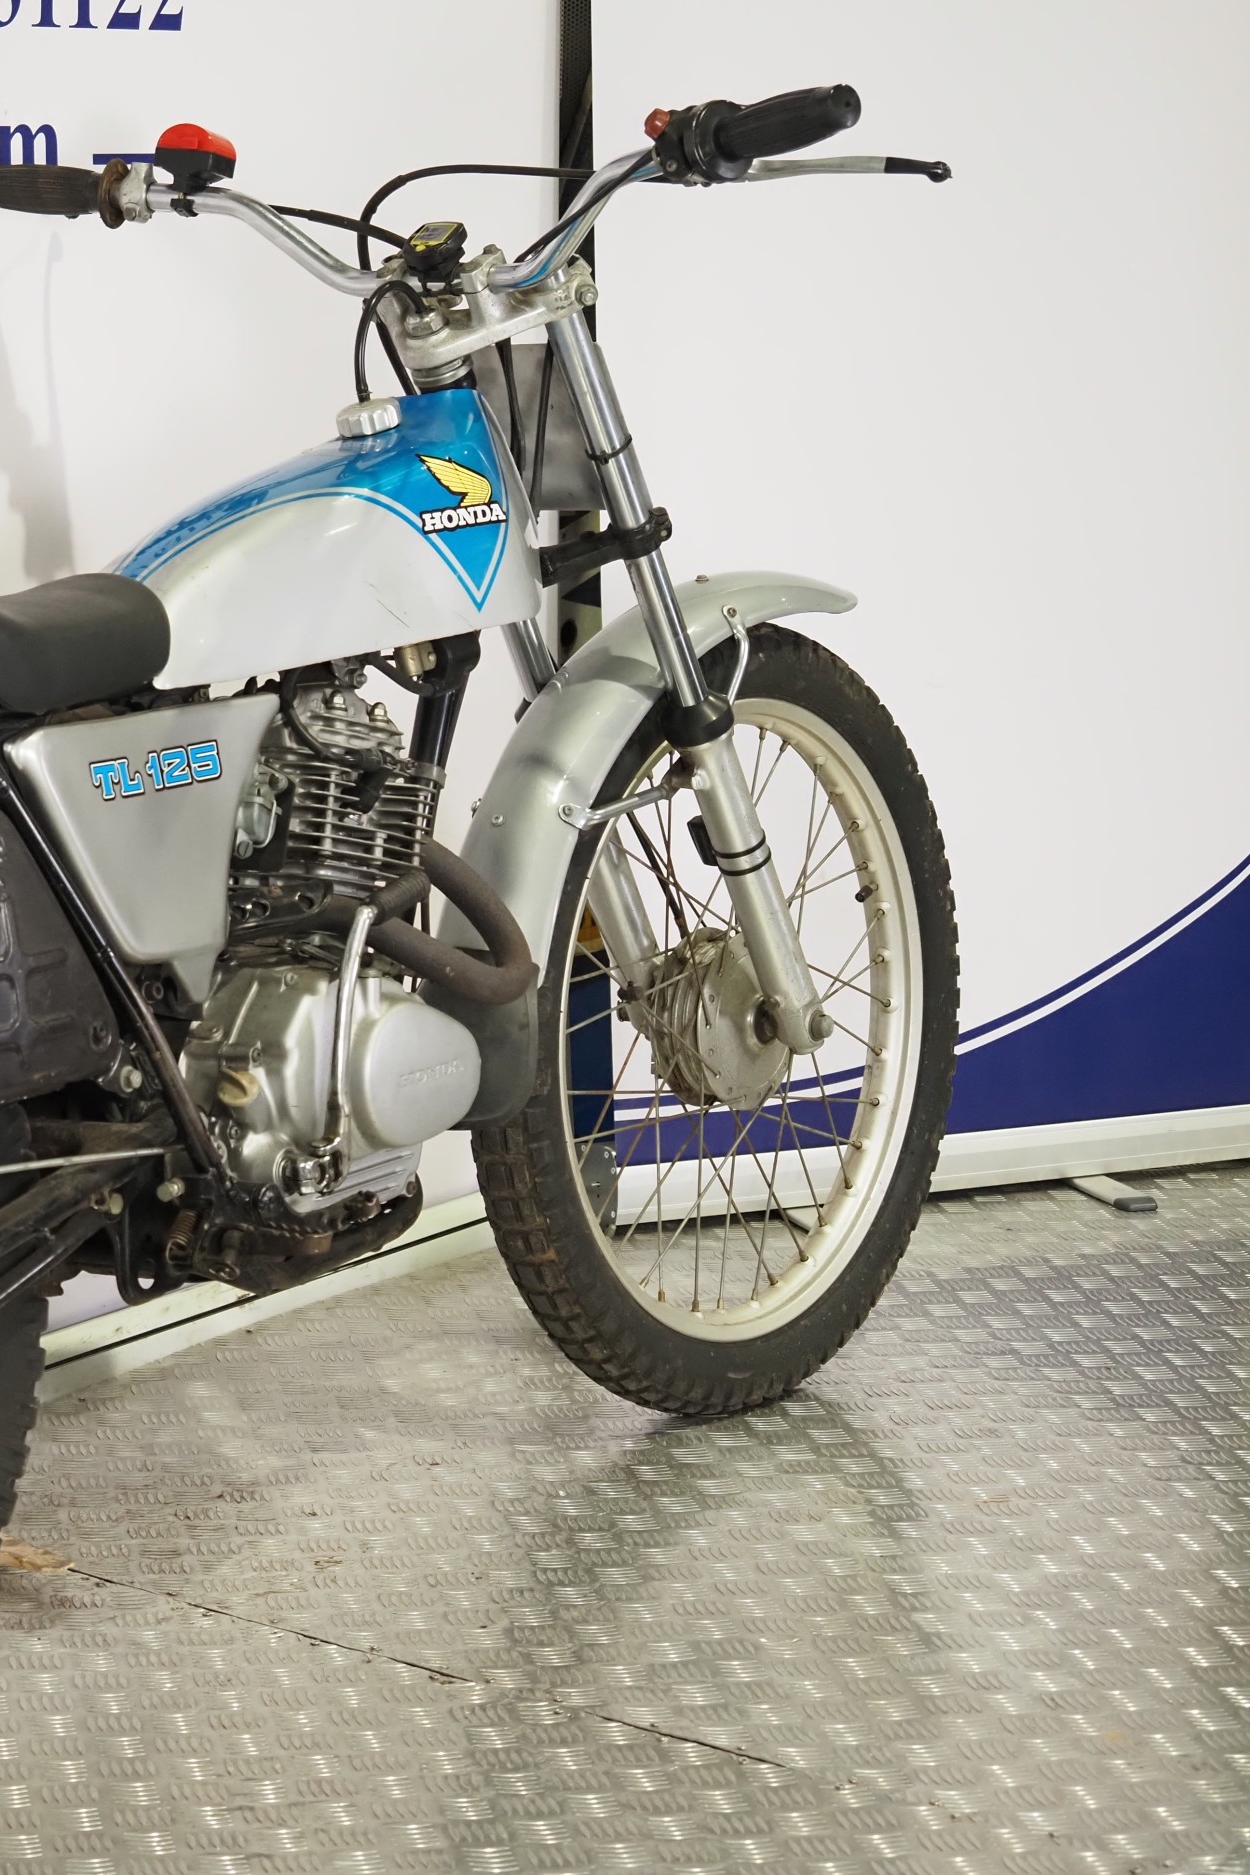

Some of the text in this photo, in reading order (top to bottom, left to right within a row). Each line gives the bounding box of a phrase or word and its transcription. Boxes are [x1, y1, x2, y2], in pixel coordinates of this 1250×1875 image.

[421, 502, 507, 533] HONDA
[90, 740, 222, 800] TL 125
